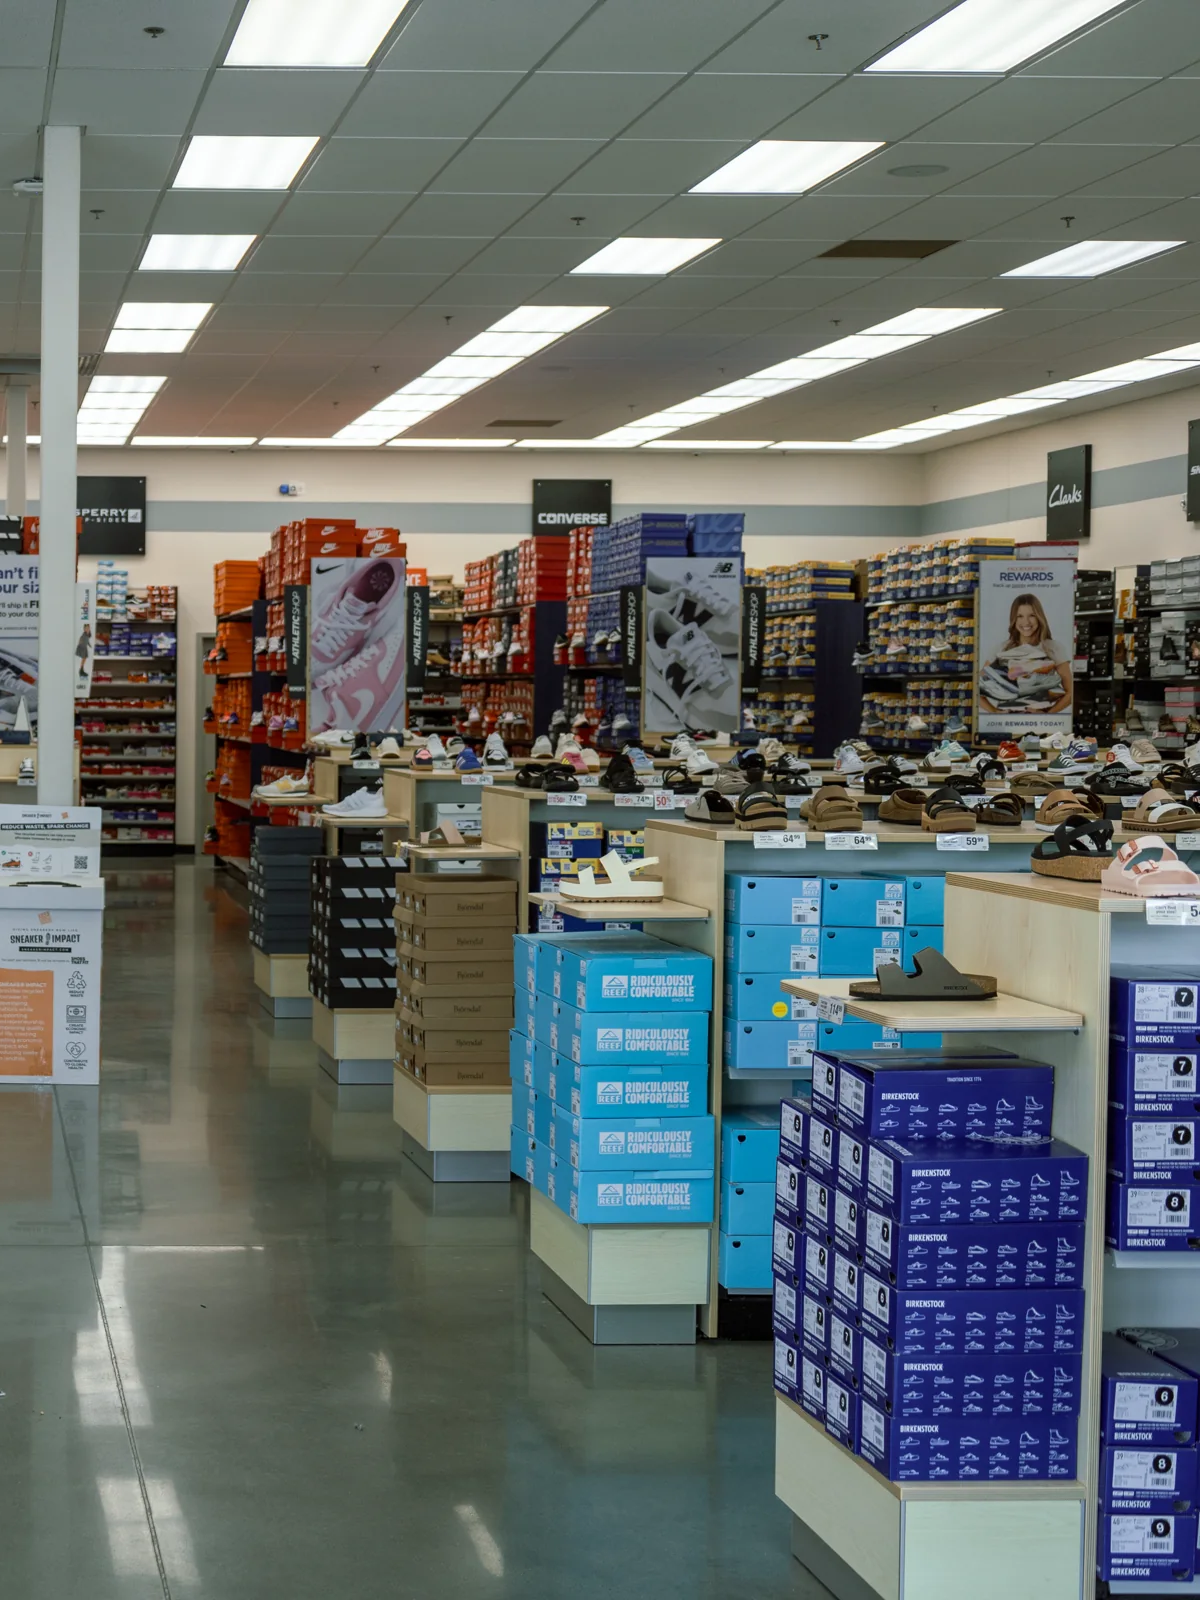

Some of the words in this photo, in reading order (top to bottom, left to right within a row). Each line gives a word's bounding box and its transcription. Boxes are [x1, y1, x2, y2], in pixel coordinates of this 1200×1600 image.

[1049, 484, 1082, 508] Clarks
[538, 512, 608, 524] CONVERSE
[1000, 572, 1054, 581] REWARDS
[10, 934, 43, 944] SNEAKER
[52, 934, 80, 943] IMPACT
[630, 975, 694, 986] RIDICULOUSLY
[630, 987, 694, 997] COMFORTABLE
[1180, 992, 1188, 1002] 7
[625, 1029, 689, 1039] RIDICULOUSLY
[625, 1040, 689, 1050] COMFORTABLE
[1179, 1061, 1186, 1071] 7
[625, 1082, 689, 1092] RIDICULOUSLY
[625, 1092, 689, 1104] COMFORTABLE
[1134, 1103, 1172, 1111] BIRKENSTOCK
[627, 1131, 691, 1142] RIDICULOUSLY
[1178, 1131, 1185, 1140] 7
[627, 1142, 692, 1153] COMFORTABLE
[626, 1183, 690, 1194] RIDICULOUSLY
[625, 1195, 690, 1205] COMFORTABLE
[1171, 1197, 1178, 1207] 8
[1161, 1392, 1168, 1401] 6
[1159, 1458, 1166, 1469] 8
[1156, 1523, 1164, 1533] 9
